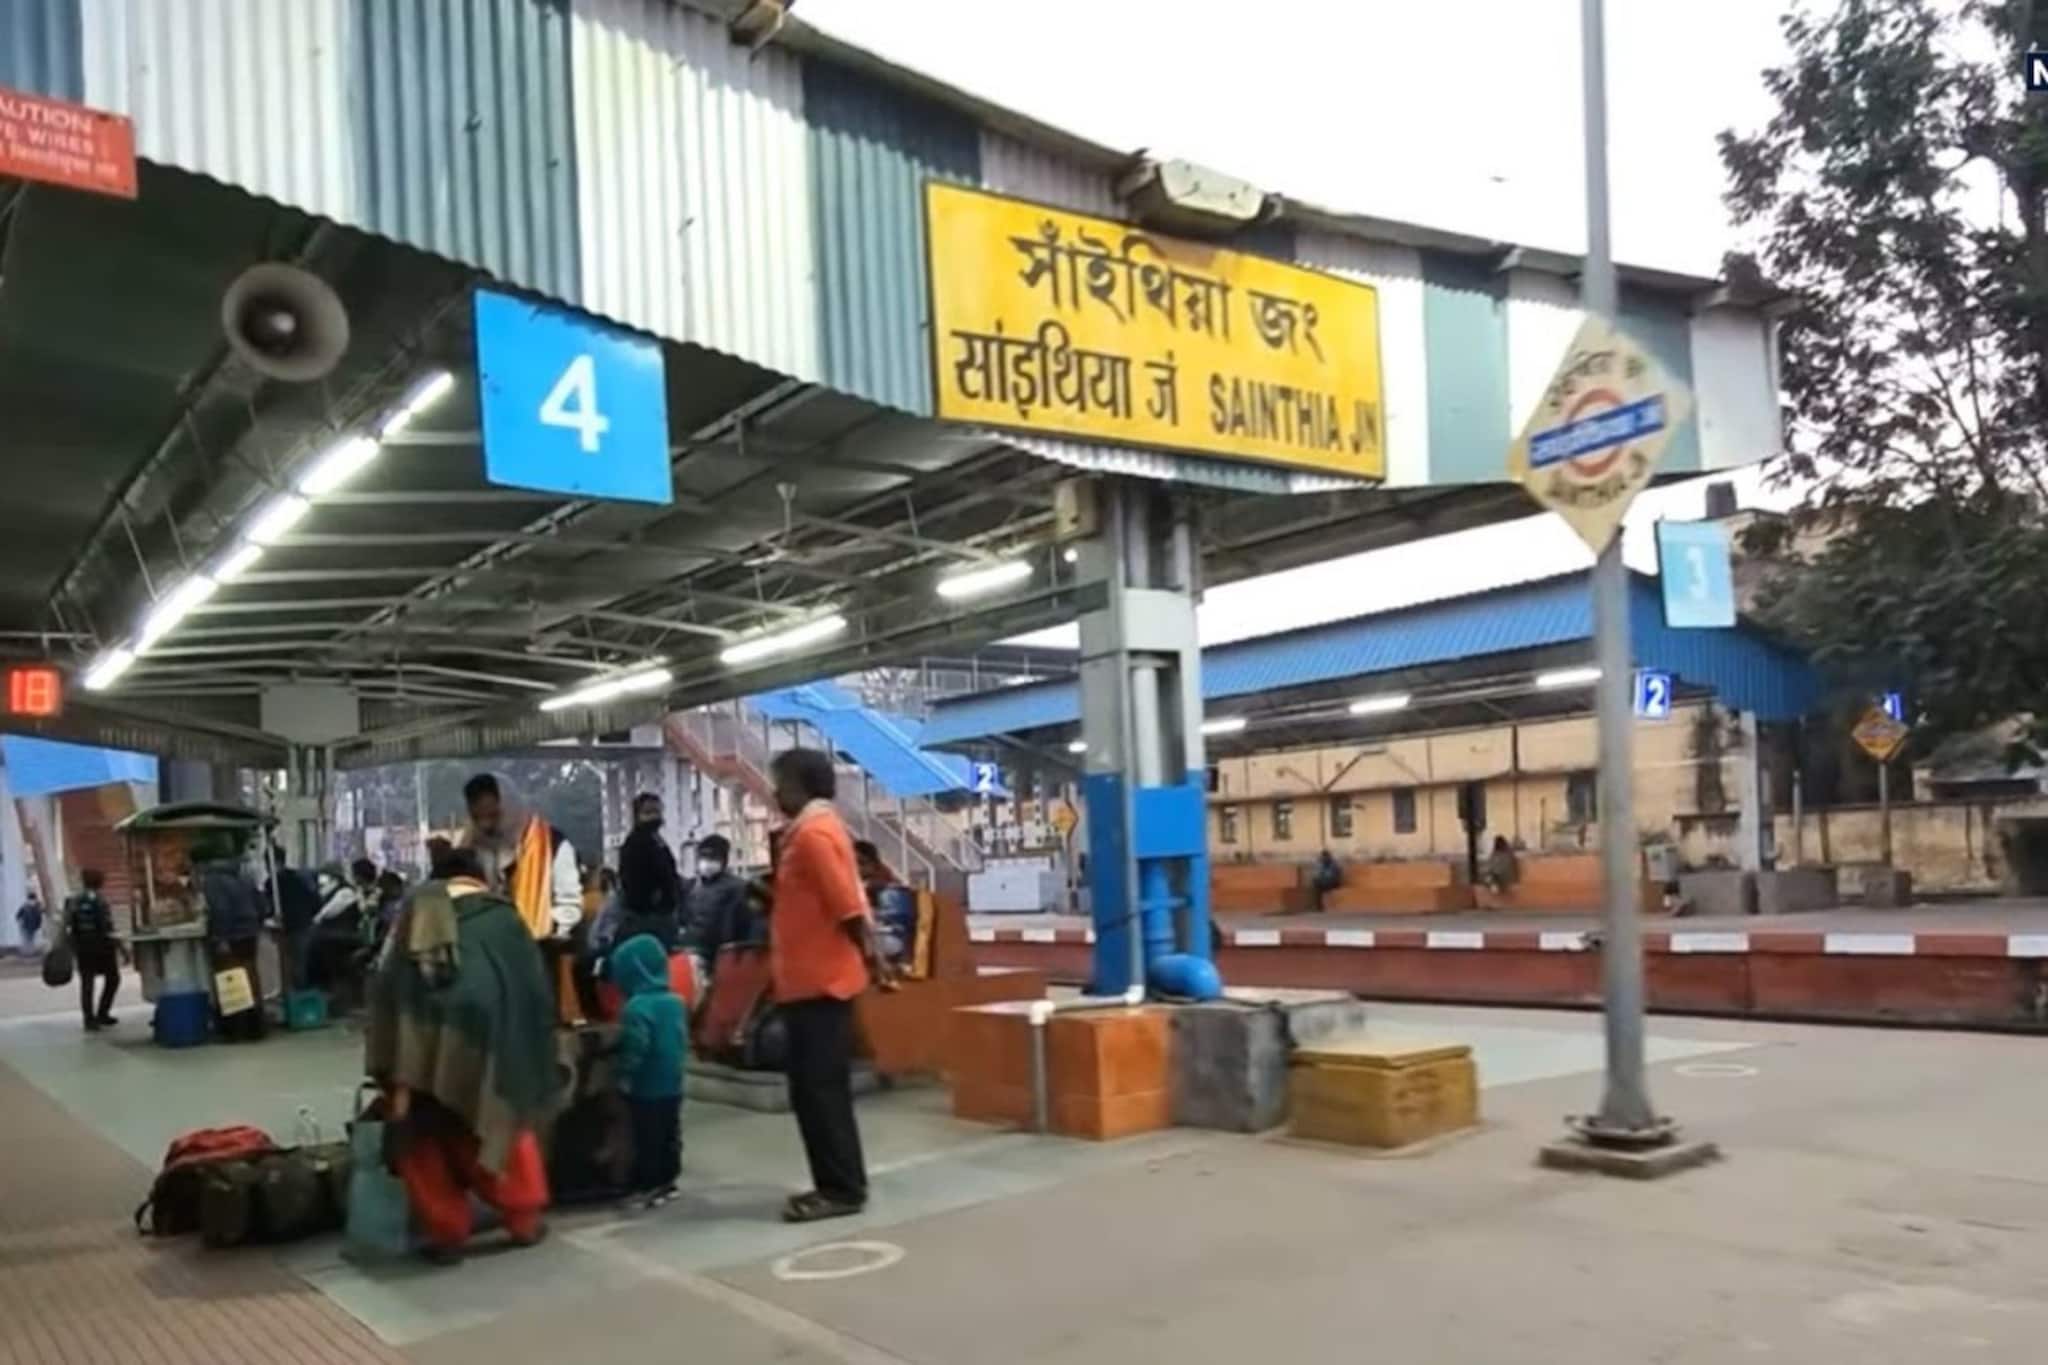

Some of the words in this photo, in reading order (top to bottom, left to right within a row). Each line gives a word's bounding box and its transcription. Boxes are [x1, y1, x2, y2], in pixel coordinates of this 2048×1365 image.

[1008, 220, 1231, 343] সাঁইথিয়া
[1247, 287, 1325, 363] জং
[540, 354, 610, 453] 4
[1144, 350, 1179, 427] जं
[1209, 371, 1344, 451] SAINTHIA
[1349, 397, 1377, 454] JN
[1647, 678, 1665, 717] 2
[978, 764, 993, 790] 2
